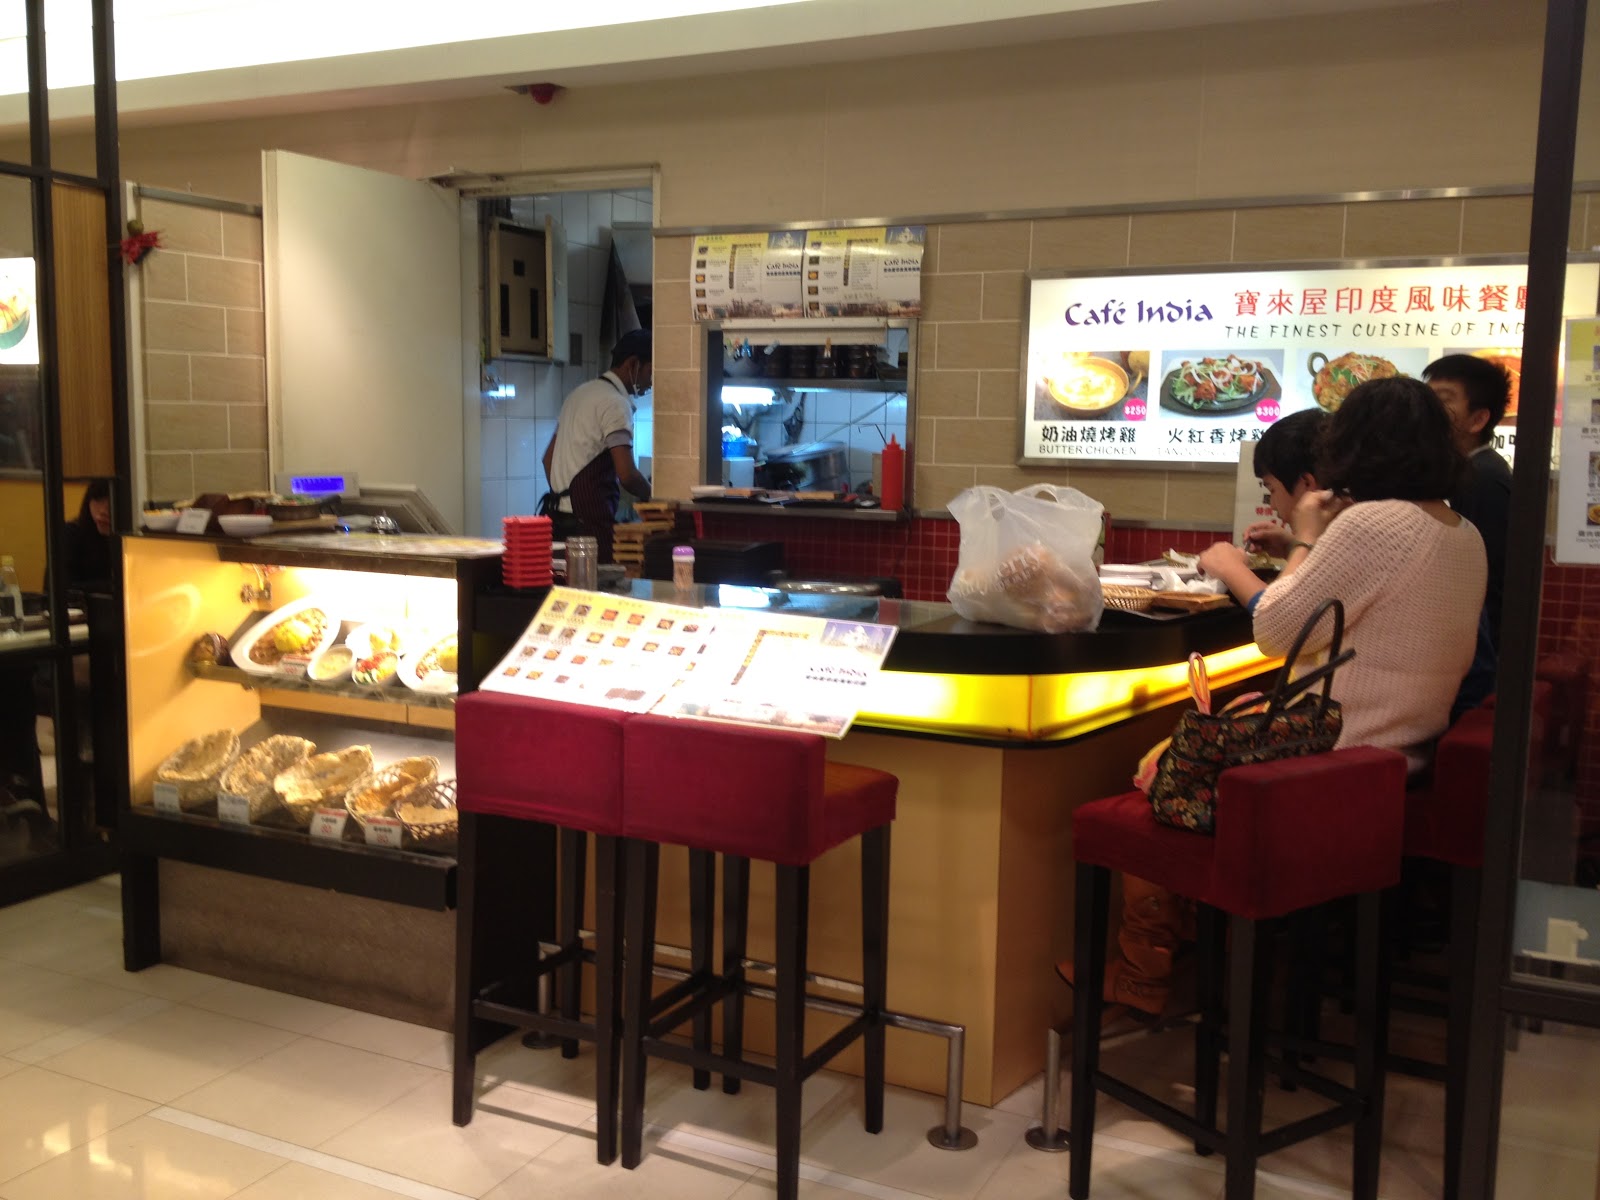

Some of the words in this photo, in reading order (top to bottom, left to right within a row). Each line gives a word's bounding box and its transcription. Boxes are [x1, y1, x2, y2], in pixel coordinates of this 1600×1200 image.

[1065, 299, 1126, 326] Café
[1137, 299, 1213, 323] India
[1225, 325, 1259, 338] THE
[1270, 324, 1342, 338] FINEST
[1352, 322, 1440, 337] CUISINE
[1451, 322, 1476, 336] OF
[1041, 425, 1137, 444] 奶油燒烤雞
[1039, 444, 1083, 454] BUTTER
[1085, 445, 1137, 455] CHICKEN
